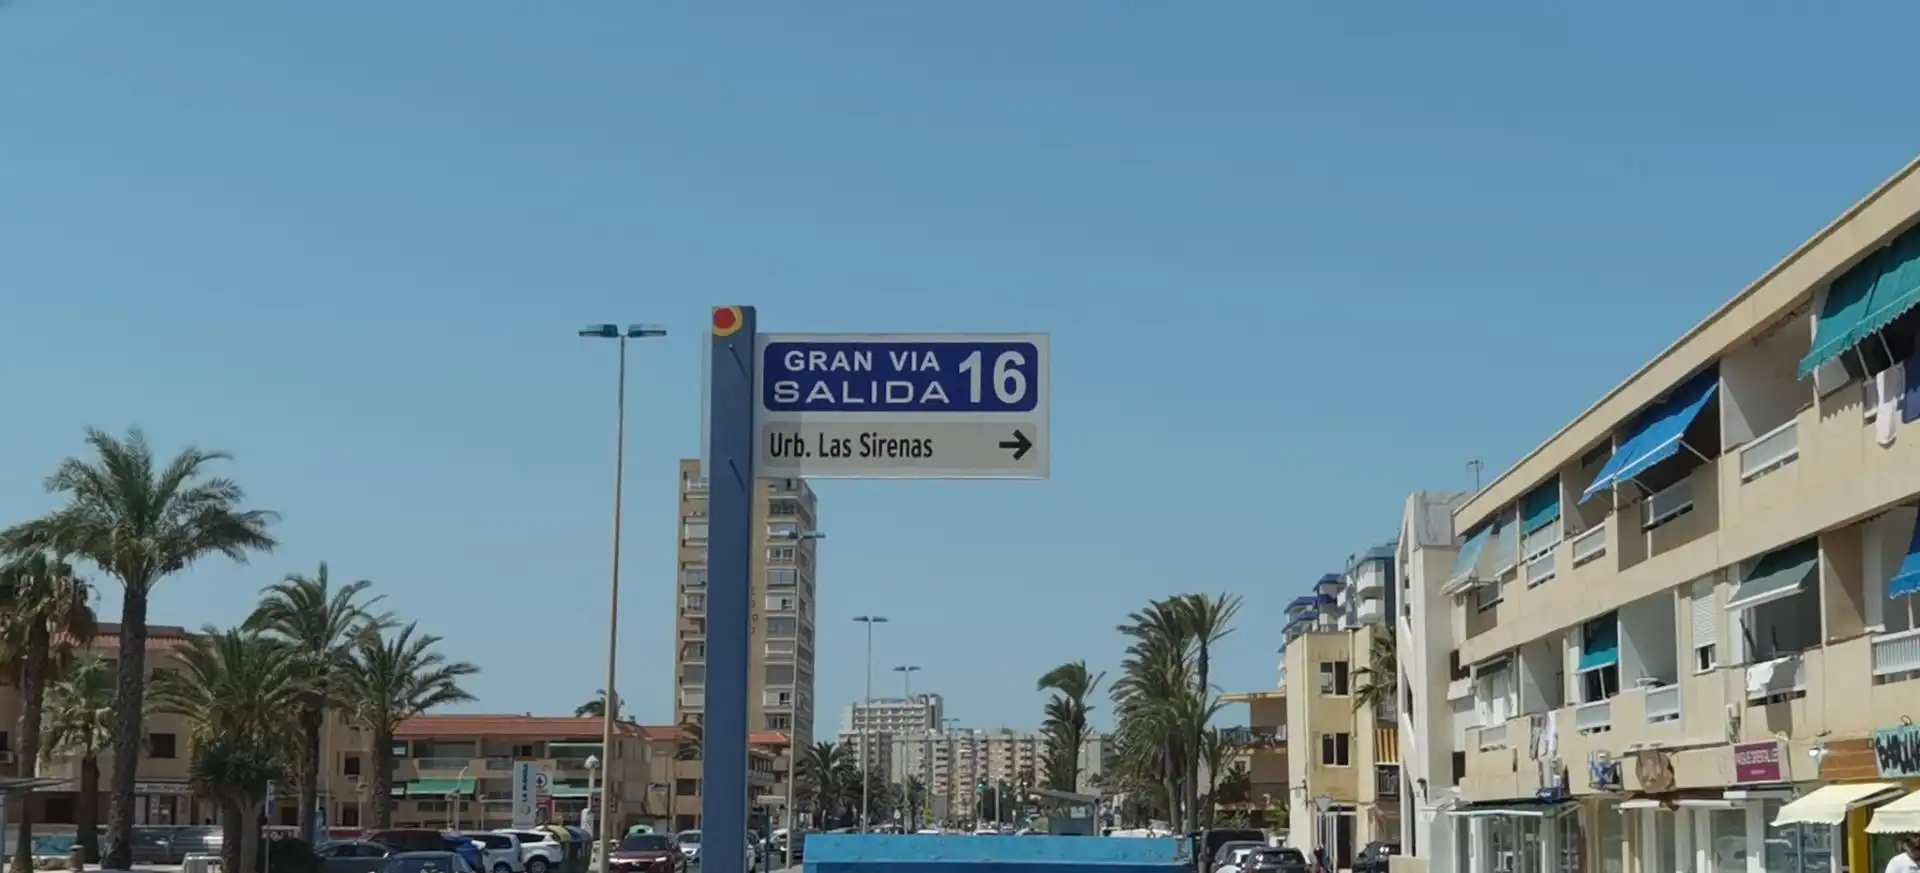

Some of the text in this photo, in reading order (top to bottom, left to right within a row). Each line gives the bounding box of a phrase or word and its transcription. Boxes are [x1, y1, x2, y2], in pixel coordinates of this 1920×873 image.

[784, 350, 940, 371] GRAN VIA
[958, 350, 1026, 404] 16
[774, 380, 950, 403] SALIDA
[769, 431, 933, 458] Urb. Las Sirenas
